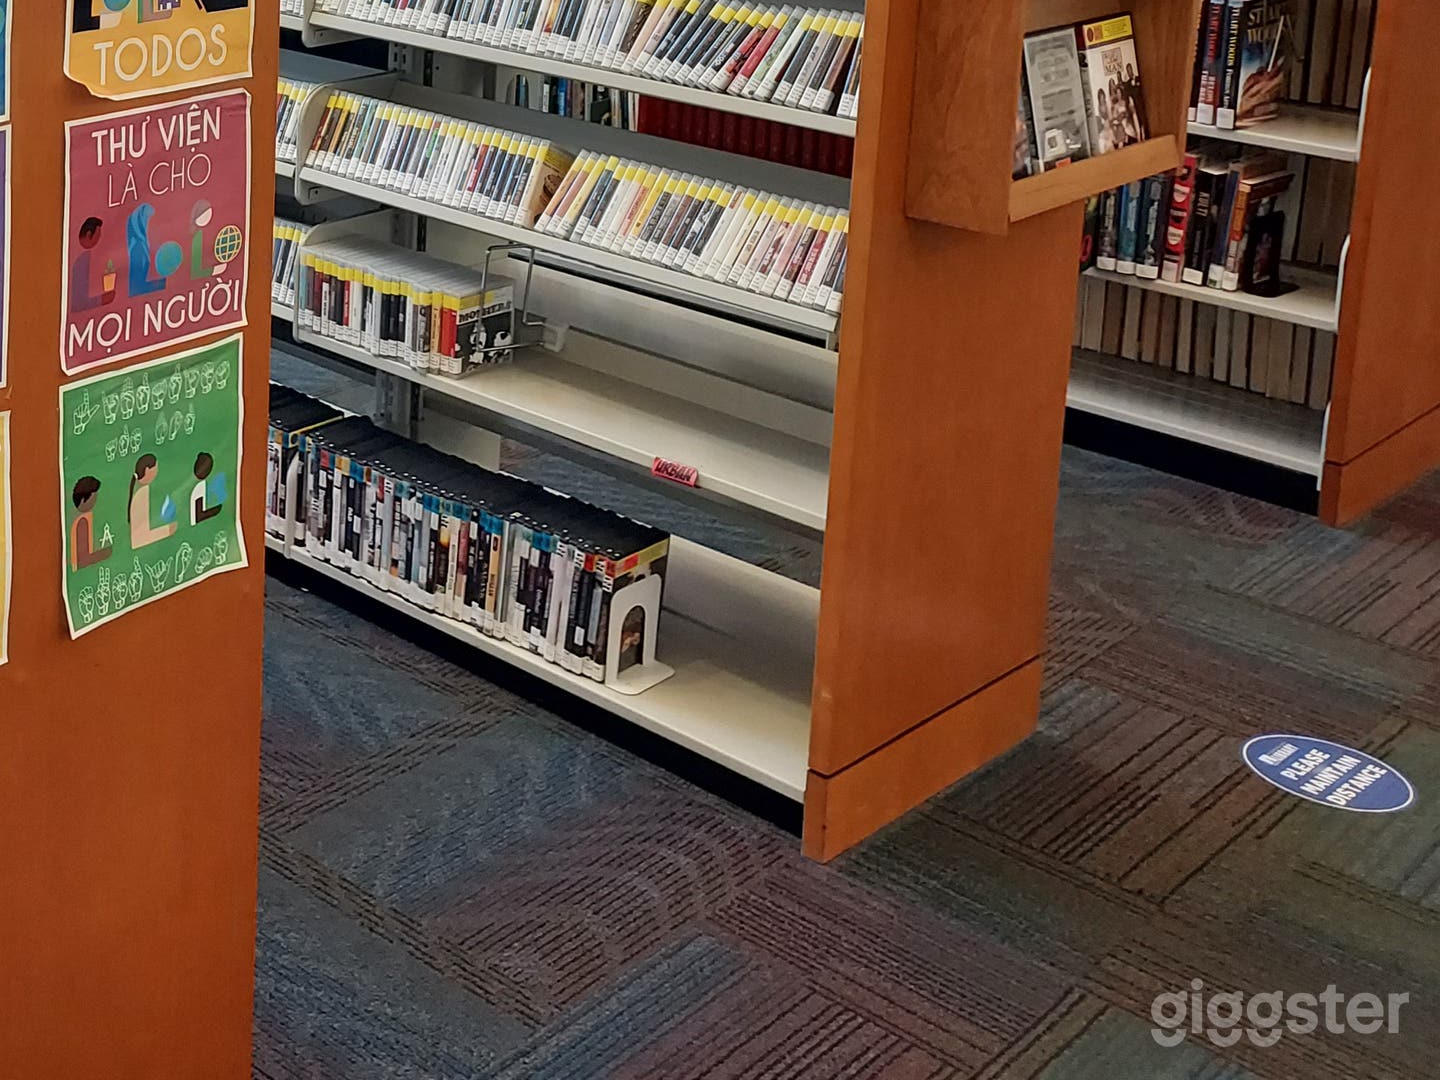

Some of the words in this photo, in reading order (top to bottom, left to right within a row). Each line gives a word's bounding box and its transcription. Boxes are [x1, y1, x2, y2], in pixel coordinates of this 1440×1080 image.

[92, 23, 228, 87] TODOS
[91, 116, 152, 166] THƯ
[158, 103, 222, 154] VIỆN
[108, 162, 139, 208] LÀ
[148, 153, 213, 197] CHO
[68, 312, 131, 361] MỌI
[144, 277, 242, 335] NGƯỜI
[1280, 748, 1331, 781] PLEASE
[1300, 754, 1362, 796] MAINTAIN
[1325, 764, 1389, 806] DISTANCE
